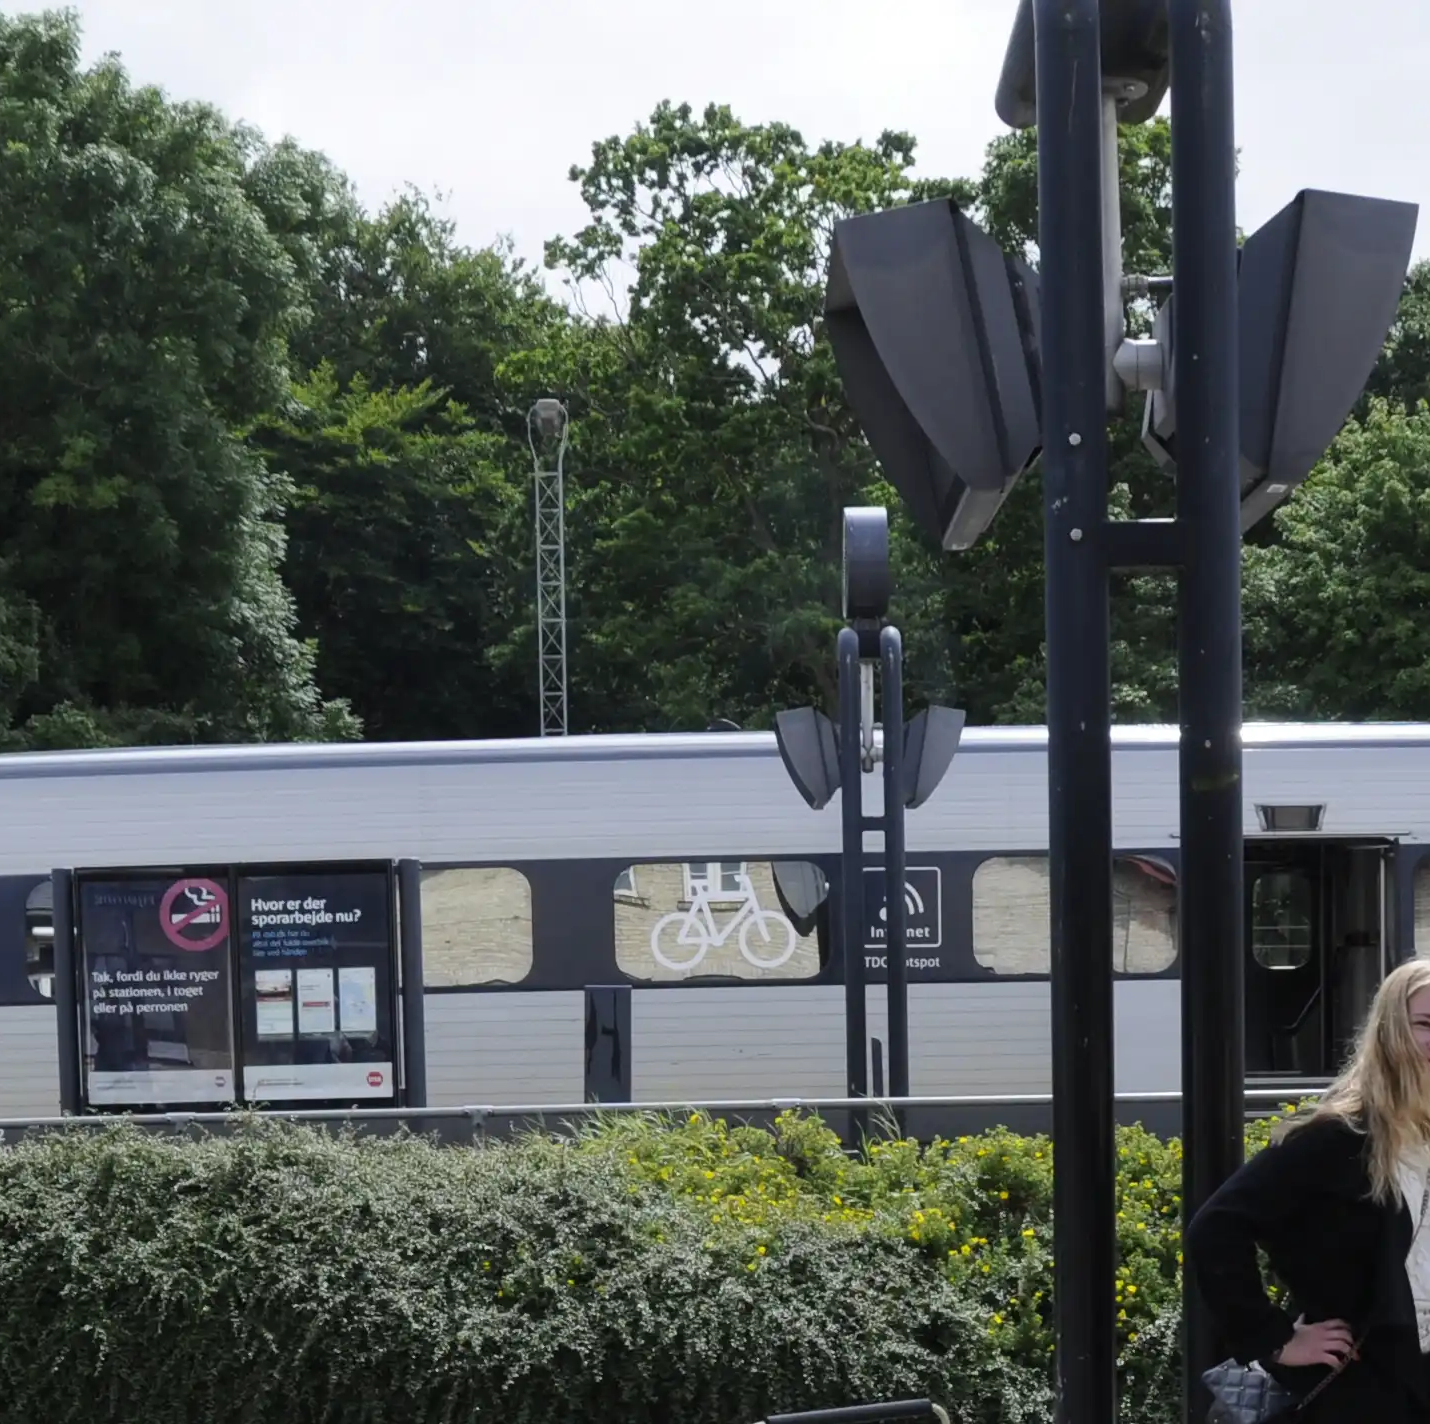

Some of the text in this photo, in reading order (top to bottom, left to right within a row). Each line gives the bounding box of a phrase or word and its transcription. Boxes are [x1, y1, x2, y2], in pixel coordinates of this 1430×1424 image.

[251, 896, 326, 911] Hvor er der
[251, 909, 362, 928] sporarbejde nu?
[92, 970, 219, 984] Tak, fordi du ikke ryger
[92, 987, 106, 1000] på
[109, 985, 165, 998] stationen,
[174, 985, 203, 997] toget
[93, 1001, 188, 1015] eller på perronen
